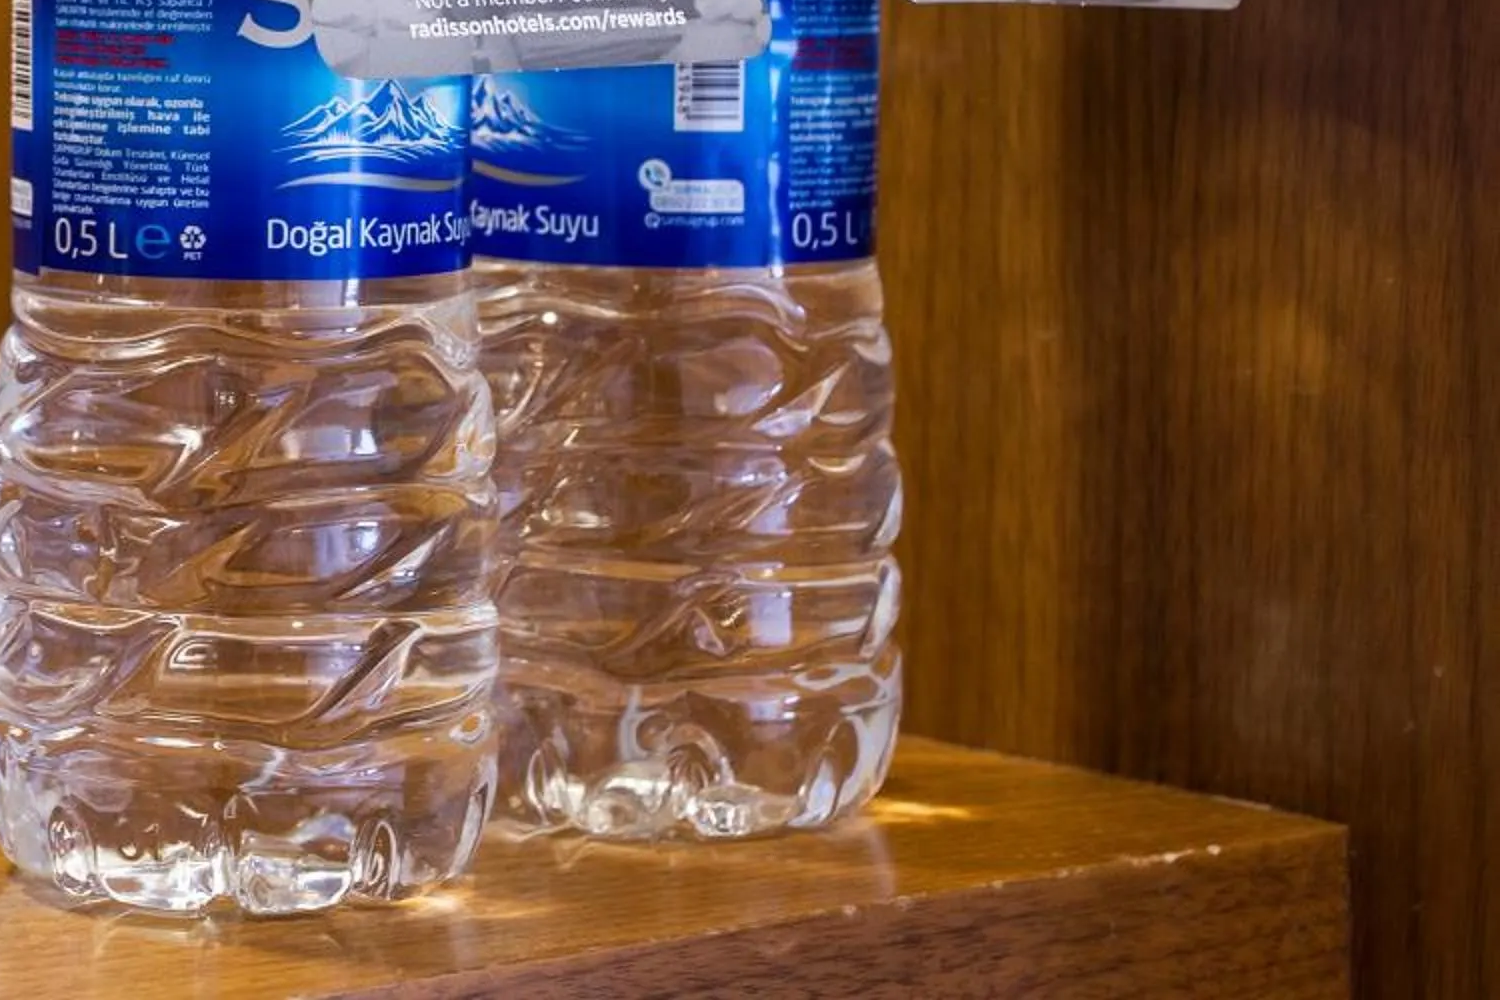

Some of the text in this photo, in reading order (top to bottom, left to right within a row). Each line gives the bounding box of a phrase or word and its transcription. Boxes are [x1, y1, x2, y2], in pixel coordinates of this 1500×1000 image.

[410, 7, 687, 40] radissonhotels.com/rewards
[55, 217, 98, 260] 0,5
[109, 221, 129, 260] L
[266, 218, 352, 257] Doğal
[358, 213, 441, 254] Kaynak
[535, 205, 599, 244] Suyu
[791, 211, 839, 251] 0,5
